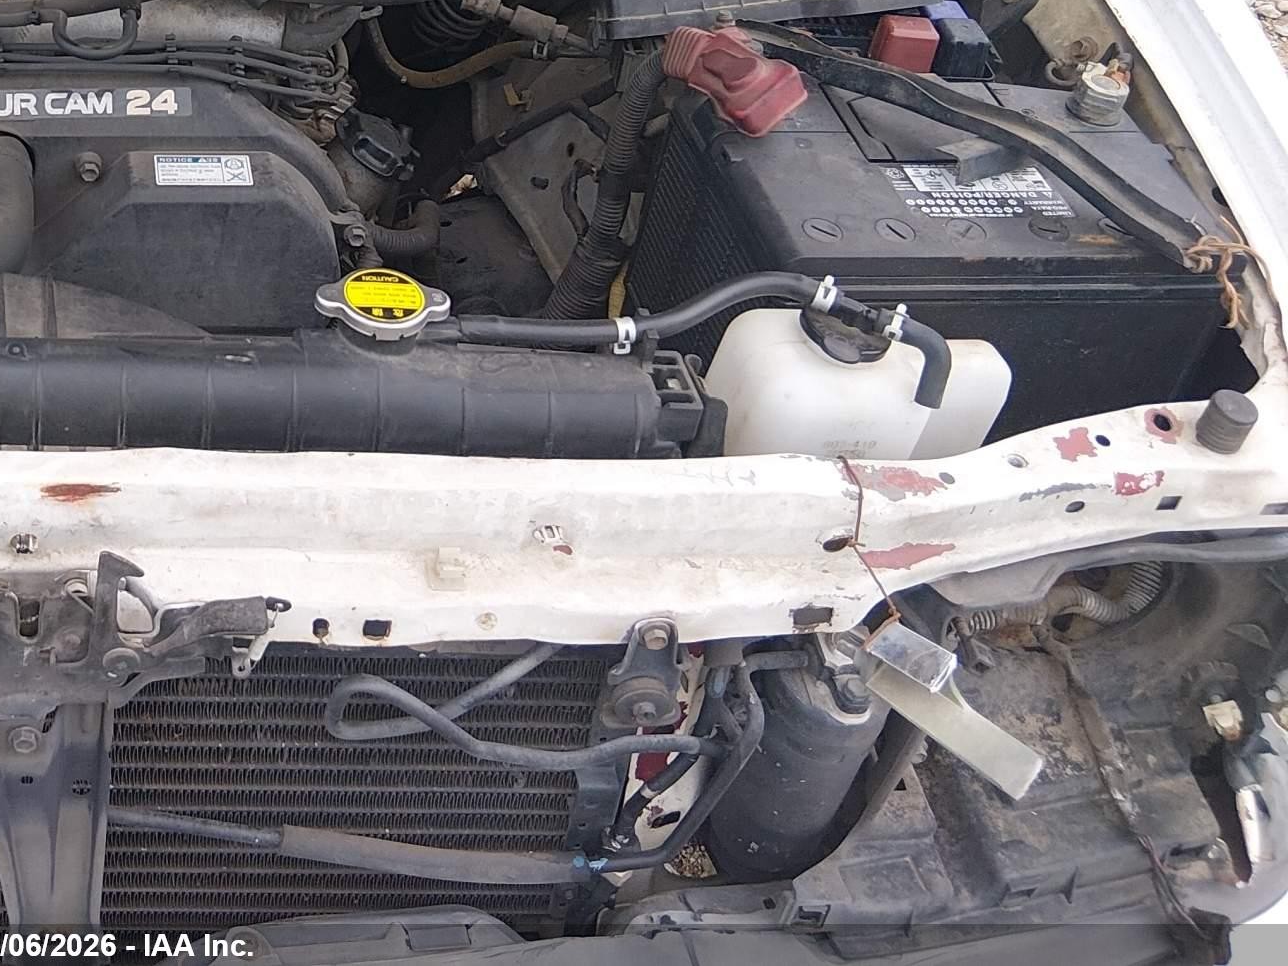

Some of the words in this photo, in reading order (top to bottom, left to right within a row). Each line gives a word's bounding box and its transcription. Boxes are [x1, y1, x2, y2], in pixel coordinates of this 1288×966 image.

[44, 91, 113, 115] CAM
[126, 89, 179, 116] 24
[931, 191, 1038, 199] DANGER/POISON
[361, 275, 399, 283] CAUTION
